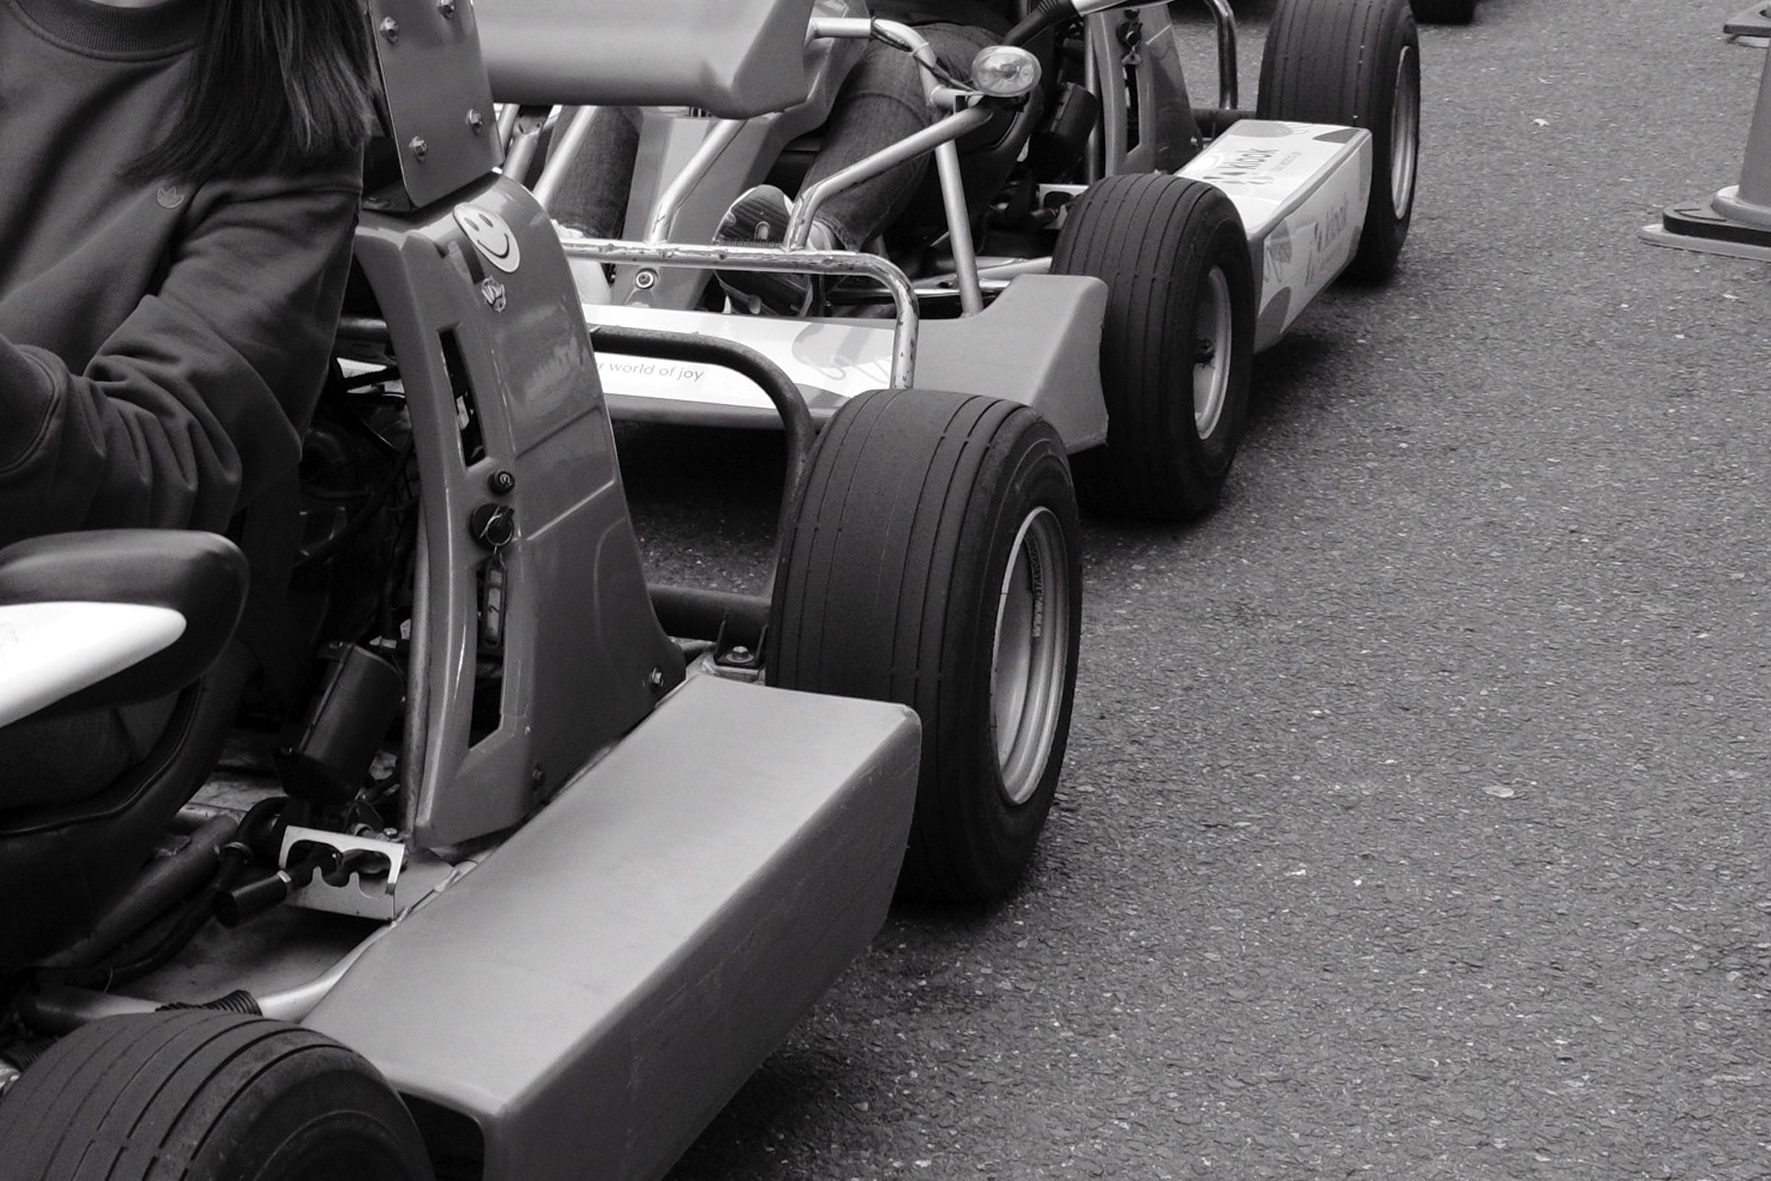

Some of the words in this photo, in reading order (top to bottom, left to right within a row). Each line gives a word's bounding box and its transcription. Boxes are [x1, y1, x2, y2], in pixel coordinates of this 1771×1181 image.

[610, 363, 655, 375] world
[659, 366, 677, 377] of
[676, 367, 704, 382] joy
